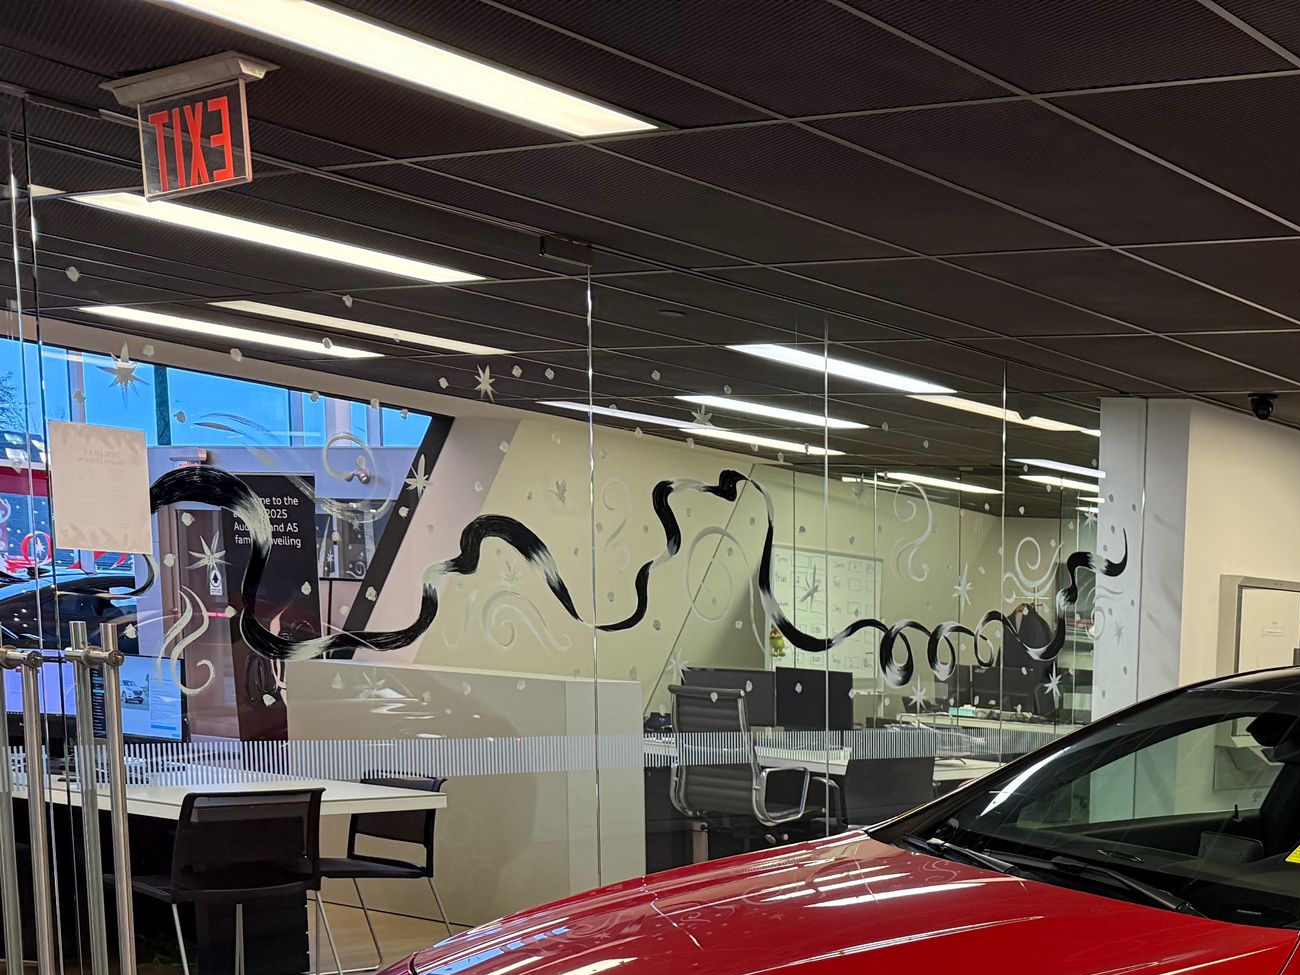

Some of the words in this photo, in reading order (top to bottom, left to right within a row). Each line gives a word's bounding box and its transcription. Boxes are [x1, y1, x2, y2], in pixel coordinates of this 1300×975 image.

[272, 496, 282, 505] to
[283, 495, 299, 505] the
[266, 508, 288, 519] 2025
[270, 522, 284, 532] and
[286, 522, 299, 532] A5
